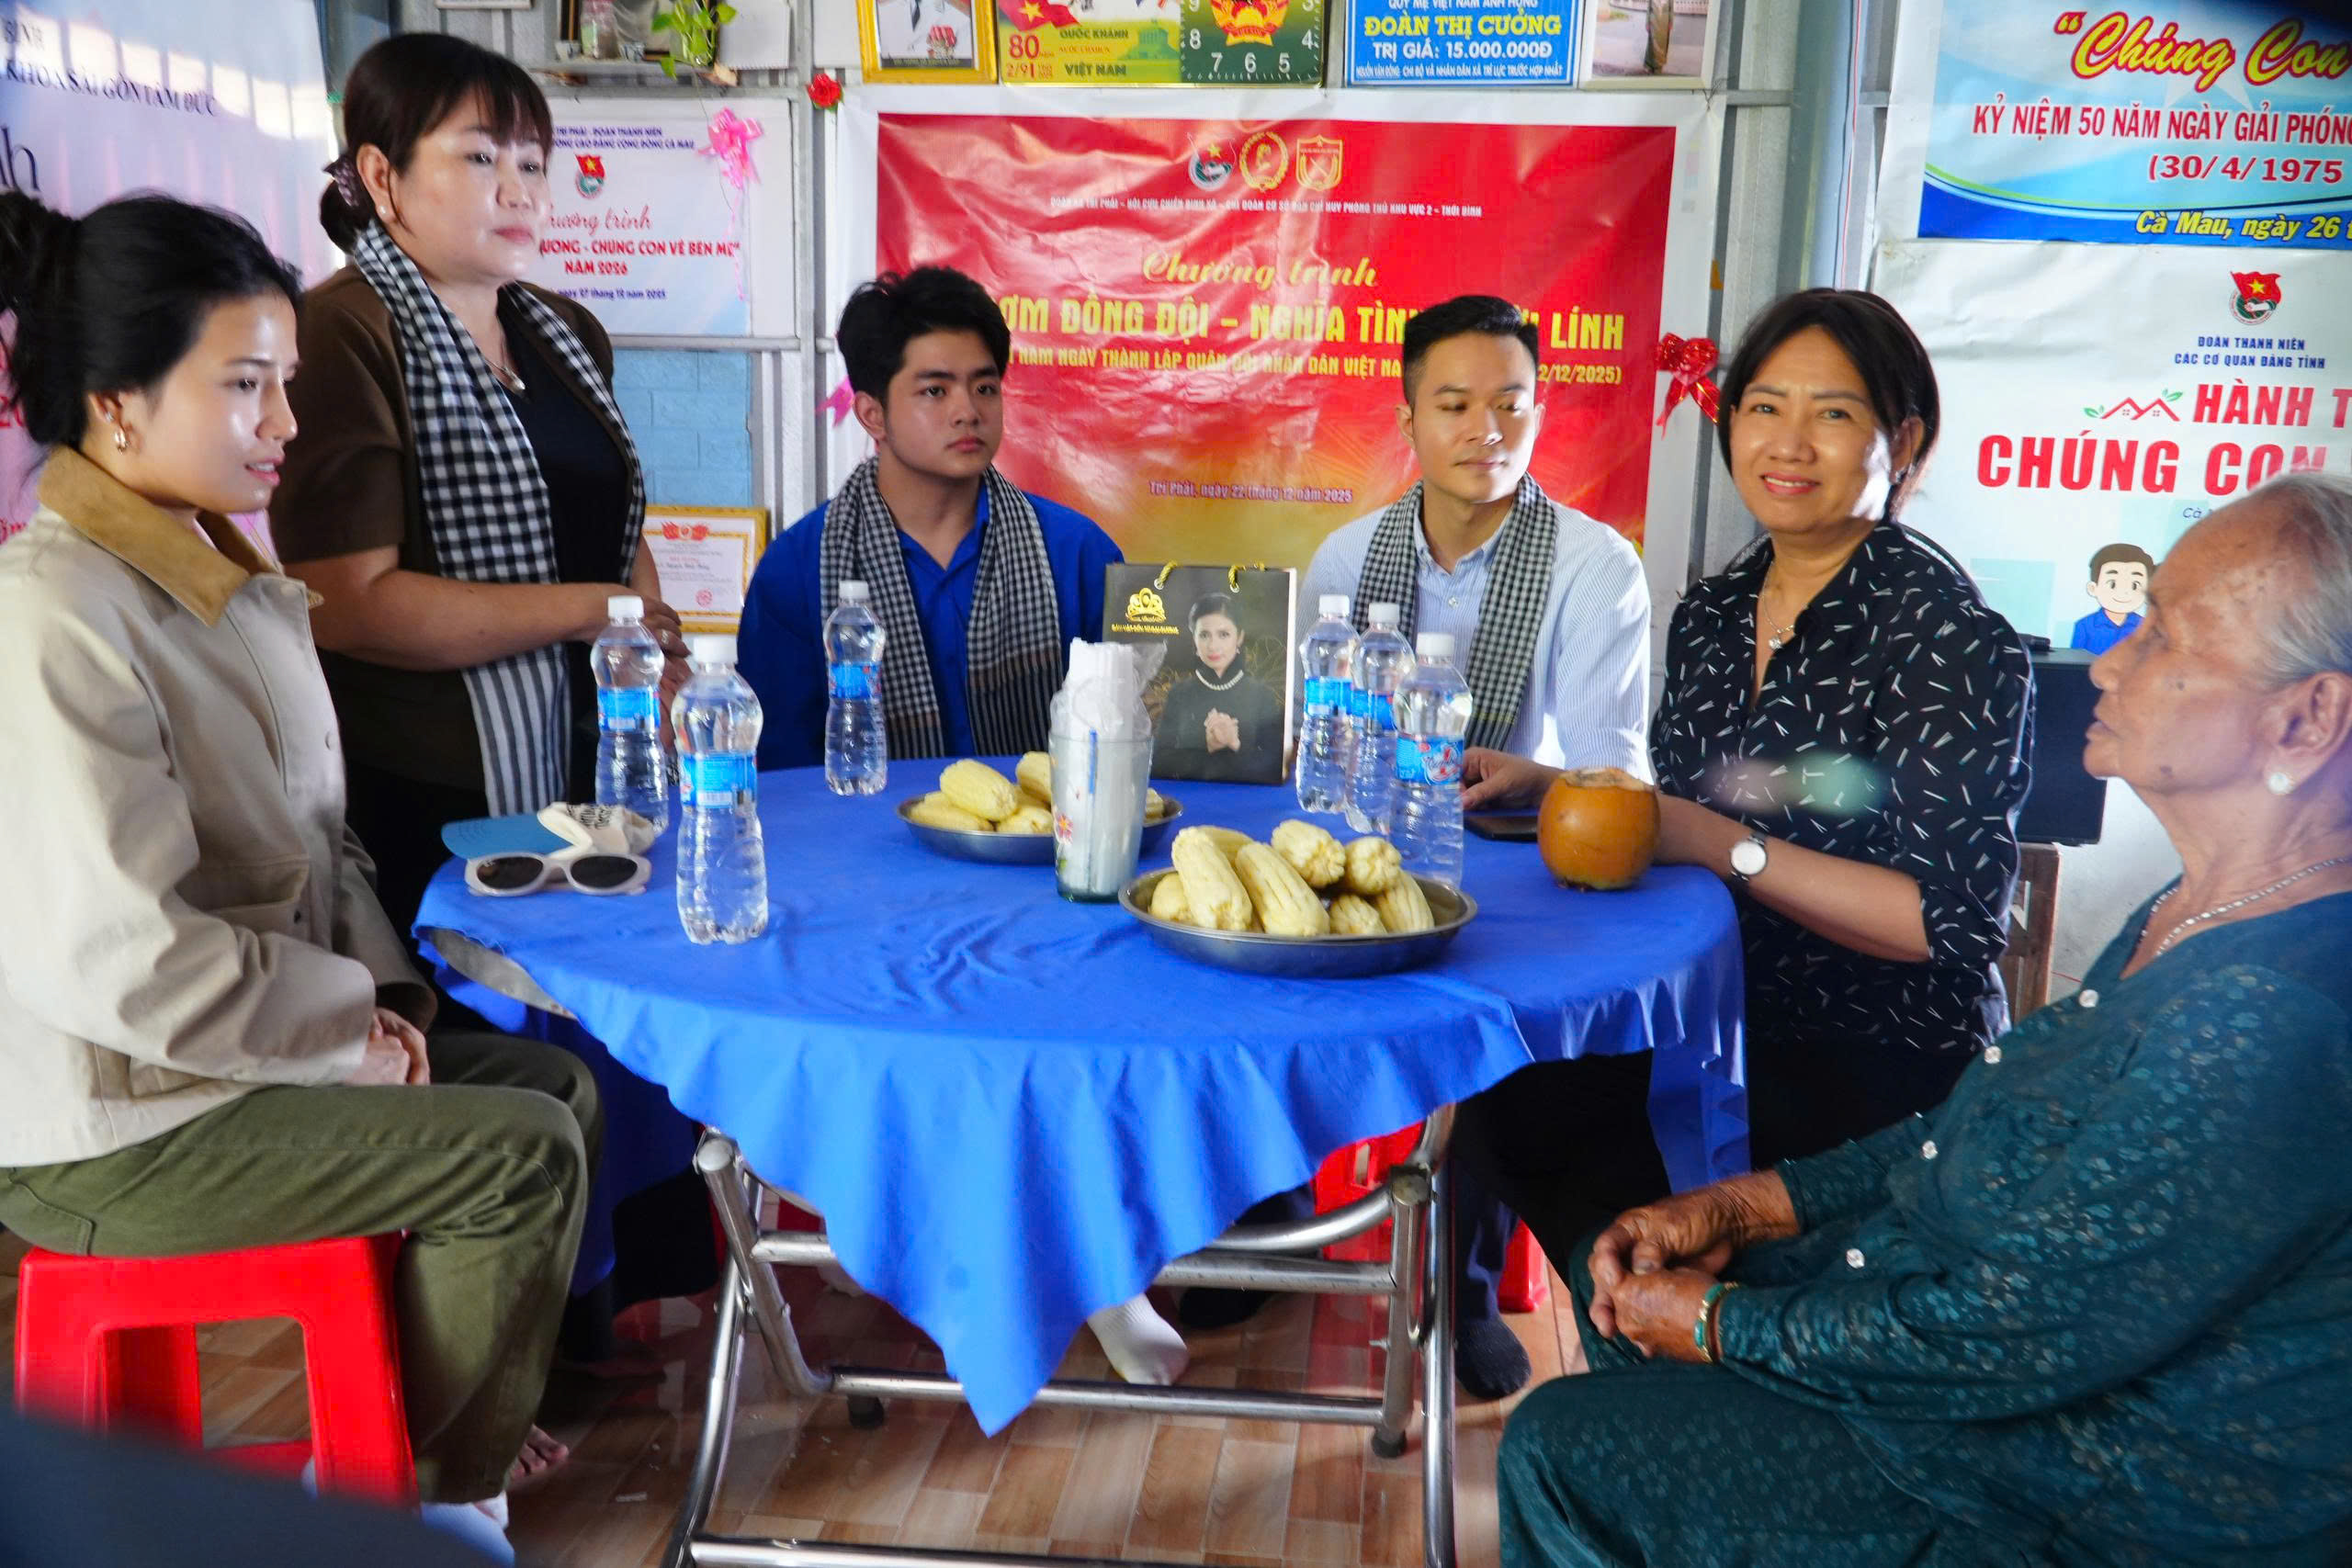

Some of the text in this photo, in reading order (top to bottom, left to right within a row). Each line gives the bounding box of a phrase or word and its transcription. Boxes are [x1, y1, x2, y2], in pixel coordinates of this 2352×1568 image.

[1364, 10, 1430, 36] ĐOÀN
[1434, 15, 1473, 39] THỊ
[1008, 34, 1040, 60] 80
[1190, 28, 1202, 50] 8
[1302, 28, 1314, 50] 4
[1373, 37, 1553, 62] TRỊ GIÁ: 15.000.000Đ
[1095, 64, 1126, 76] NAM
[1211, 52, 1291, 73] 7 6 5
[1973, 93, 2006, 136] KỶ
[2012, 97, 2071, 141] NIỆM
[2078, 107, 2105, 136] 50
[2112, 103, 2161, 141] NĂM
[2167, 102, 2228, 141] NGÀY
[2234, 101, 2279, 143] GIẢI
[2135, 210, 2168, 234] Cà
[2175, 210, 2233, 240] Mau,
[2241, 213, 2301, 241] ngày
[2305, 216, 2342, 239] 26
[639, 241, 667, 256] CON
[999, 292, 1049, 333] ƠM
[1060, 286, 1146, 336] ĐỒNG
[1155, 295, 1211, 346] ĐỘI
[1250, 299, 1346, 344] NGHĨA
[1356, 299, 1419, 344] TÌN
[1550, 305, 1623, 350] LÍNH
[2198, 334, 2305, 351] ĐOÀN THANH NIÊN
[1307, 353, 1340, 376] DÂN
[1343, 354, 1377, 380] VIỆT
[1381, 358, 1404, 378] NA
[2175, 352, 2199, 365] CÁC
[2203, 353, 2219, 366] CƠ
[2223, 355, 2256, 367] QUAN
[1537, 363, 1623, 385] 2/12/2025)
[2192, 378, 2314, 427] HÀNH
[1977, 430, 2180, 494] CHÚNG
[1323, 488, 1353, 503] 2025
